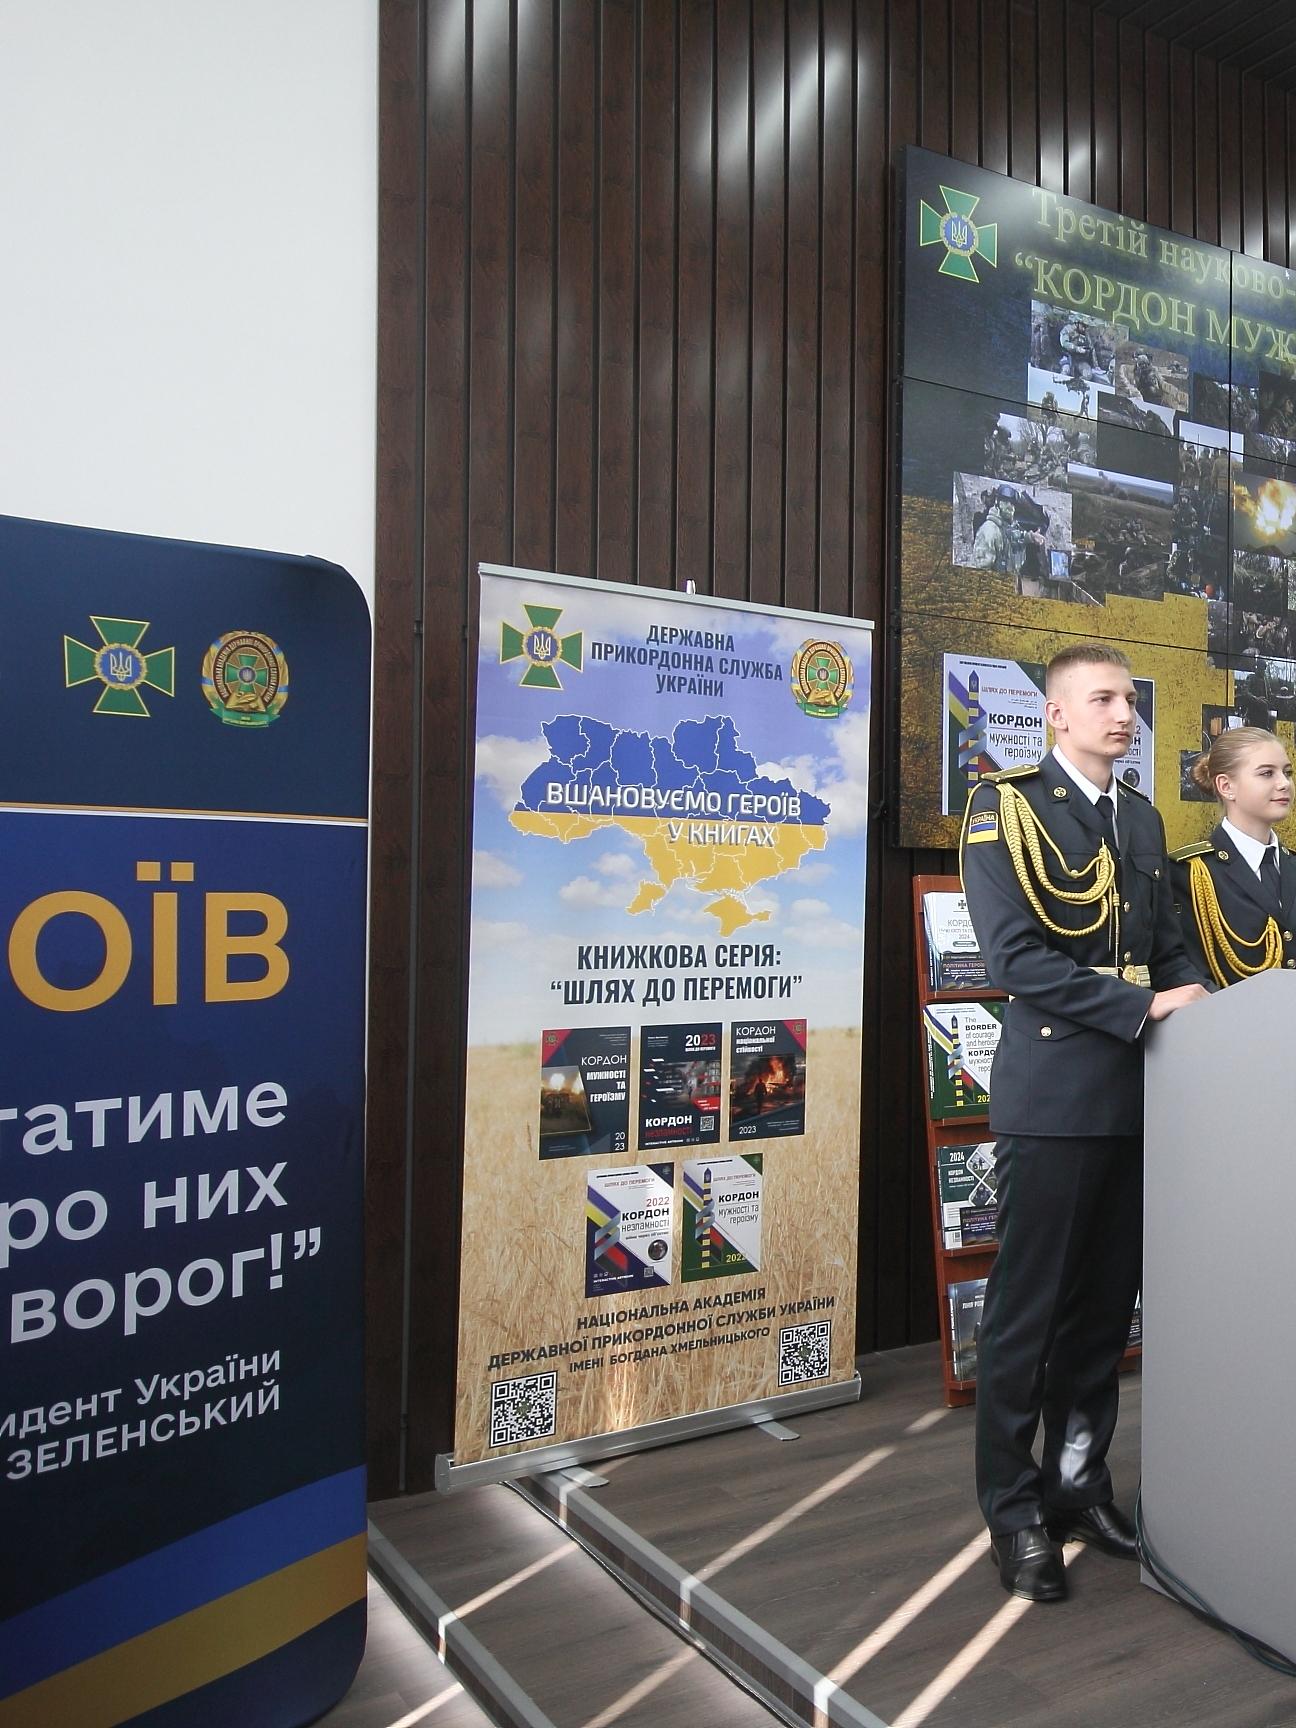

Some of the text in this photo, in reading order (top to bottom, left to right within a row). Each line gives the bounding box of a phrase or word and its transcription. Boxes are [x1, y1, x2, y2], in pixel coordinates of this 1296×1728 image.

[1032, 187, 1148, 258] Третій
[1015, 252, 1195, 330] “КОРДОН
[646, 625, 735, 653] ДЕРЖАВНА
[591, 643, 714, 674] ПРИКОРДОННА
[718, 657, 783, 682] СЛУЖБА
[656, 672, 724, 698] УКРАЇНИ
[1008, 689, 1038, 697] ПЕРЕМОГИ
[989, 713, 1042, 728] КОРДОН
[989, 733, 1042, 747] мужності та
[1005, 747, 1041, 761] героїзму
[546, 782, 801, 818] ВШАНОВУЄМО ГЕРОЇВ
[972, 814, 995, 825] УКРАЇНА
[668, 822, 776, 848] У КНИГАХ
[577, 943, 782, 970] КНИЖКОВА СЕРІЯ:
[551, 975, 803, 1007] “ШЛЯХ ДО ПЕРЕМОГИ”
[736, 1026, 776, 1036] КОРДОН
[973, 1032, 995, 1040] courage
[685, 1034, 716, 1047] 2023
[582, 1055, 627, 1066] КОРДОН
[587, 1070, 626, 1081] МУЖНОСТІ
[616, 1081, 626, 1090] ТА
[590, 1092, 626, 1103] ГЕРОЇЗМУ
[645, 1115, 692, 1128] КОРДОН
[615, 1132, 625, 1140] 20
[739, 1126, 756, 1134] 2023
[615, 1143, 625, 1151] 23
[950, 1152, 965, 1162] 2024
[144, 1162, 288, 1229] них
[646, 1197, 670, 1208] 2022
[718, 1191, 759, 1203] КОРДОН
[622, 1208, 670, 1222] КОРДОН
[718, 1203, 759, 1218] мужності та
[621, 1217, 670, 1233] незламності
[11, 1227, 321, 1344] ворог!”
[577, 1288, 766, 1330] НАЦІОНАЛЬНА АКАДЕМІЯ
[487, 1296, 835, 1372] ДЕРЖАВНОЇ ПРИКОРДОННОЇ СЛУЖБИ УКРАЇНИ
[569, 1327, 770, 1373] ІМЕНІ БОГДАНА ХМЕЛЬНИЦЬКОГО
[134, 1350, 280, 1405] України
[6, 1379, 280, 1481] ЗЕЛЕНСЬКИЙ
